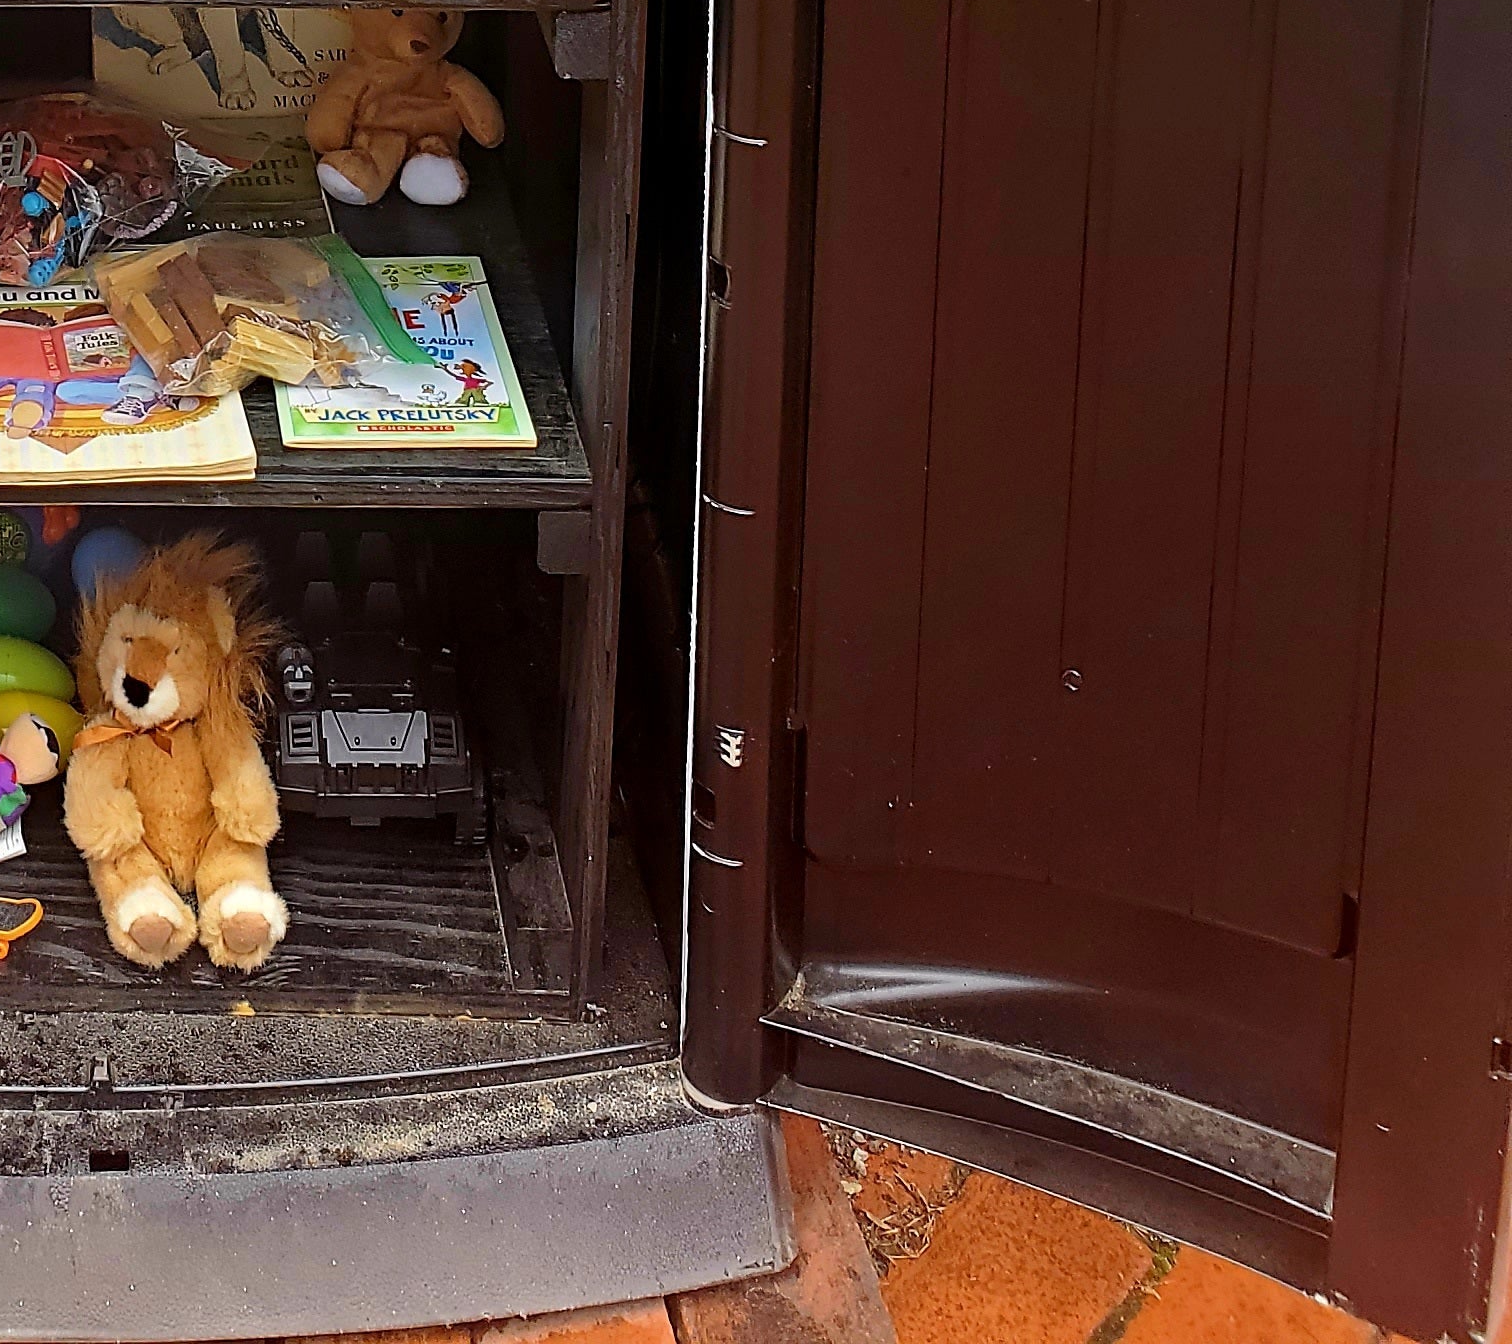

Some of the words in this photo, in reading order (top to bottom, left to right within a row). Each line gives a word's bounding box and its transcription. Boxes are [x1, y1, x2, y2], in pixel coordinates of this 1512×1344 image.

[187, 222, 241, 231] PAUL
[252, 220, 305, 230] HESS
[26, 289, 76, 301] and
[82, 333, 116, 342] Folk
[429, 338, 475, 347] ABOUT
[318, 409, 369, 421] JACK
[378, 408, 496, 422] PRELUTSKY
